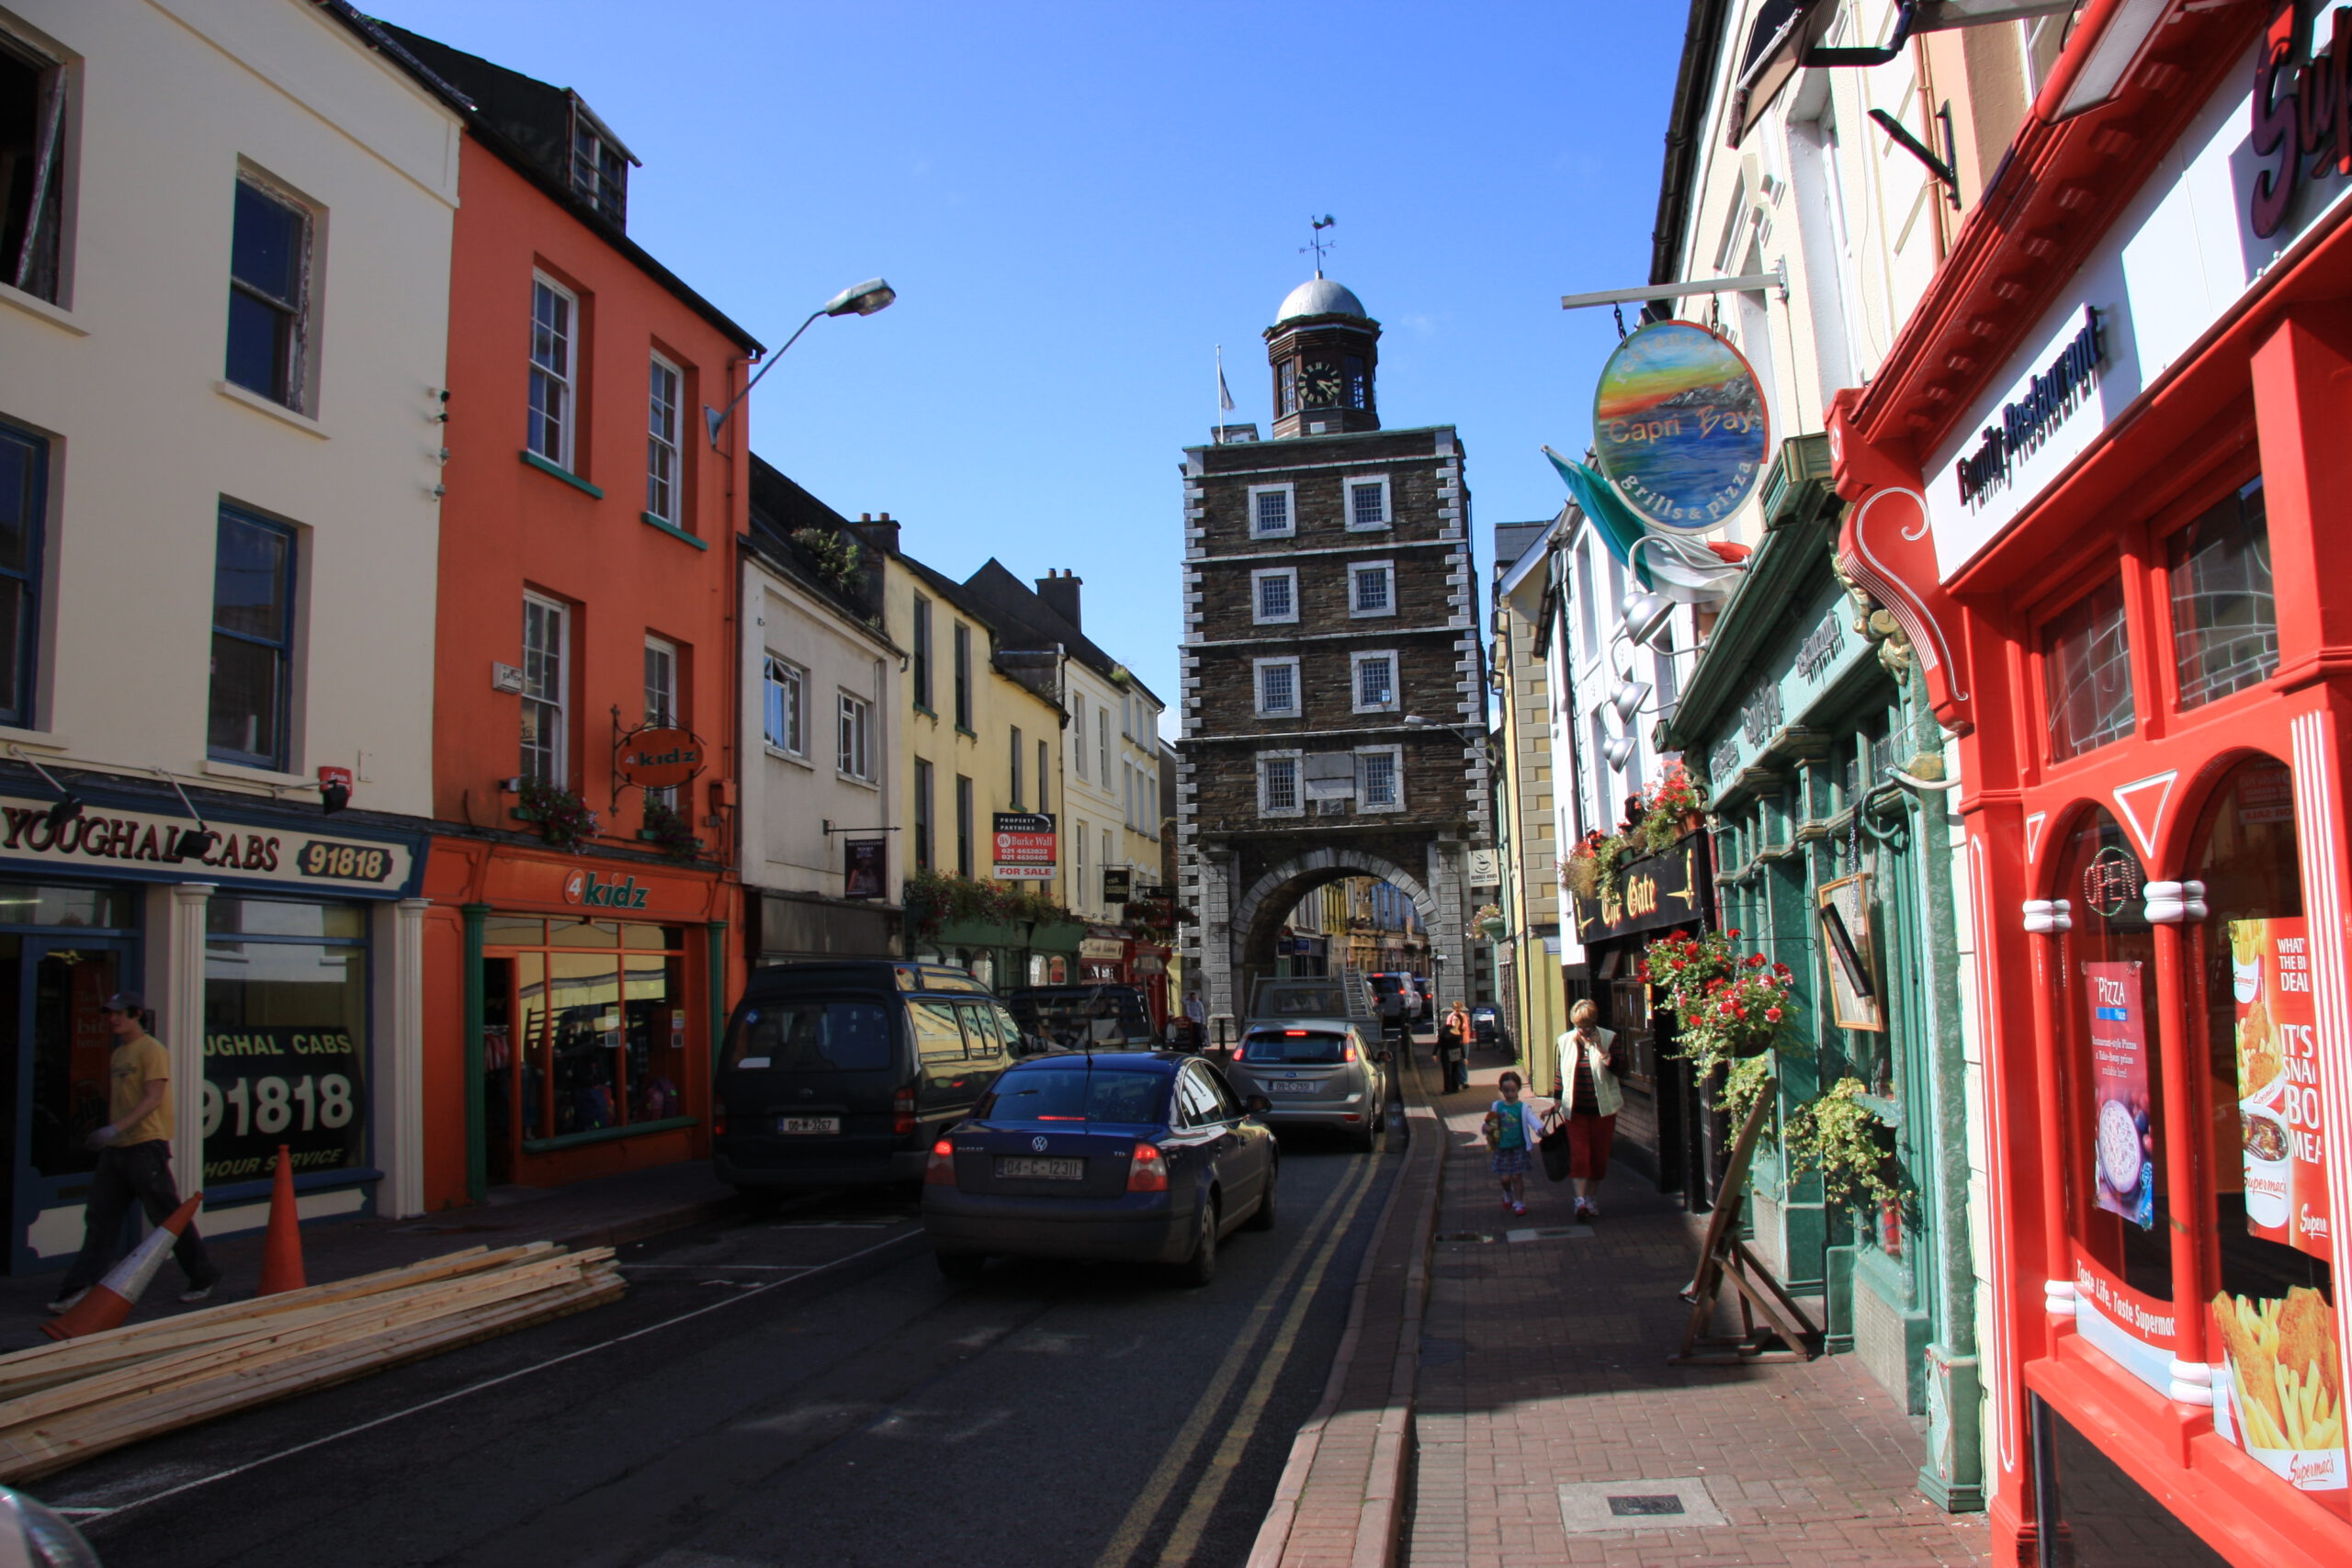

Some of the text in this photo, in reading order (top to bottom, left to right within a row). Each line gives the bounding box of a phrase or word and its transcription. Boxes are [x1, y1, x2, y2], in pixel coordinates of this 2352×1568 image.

[1609, 405, 1754, 444] Capri Bay
[1620, 461, 1752, 520] grills & pizza
[626, 747, 696, 766] 4 kidz
[2, 807, 383, 880] YOUGHAL CABS 91818
[1012, 836, 1034, 846] Burke
[1035, 836, 1052, 846] Wall
[567, 873, 650, 908] 4 kidz
[1627, 874, 1657, 919] Gate
[2083, 858, 2137, 905] OPEN
[2278, 955, 2296, 970] THE
[292, 1033, 353, 1055] CABS
[2279, 1022, 2314, 1059] IT'S
[204, 1148, 345, 1178] HOUR SRVICE
[2076, 1258, 2095, 1293] Taste
[2096, 1278, 2111, 1311] Life,
[2113, 1291, 2133, 1324] Taste
